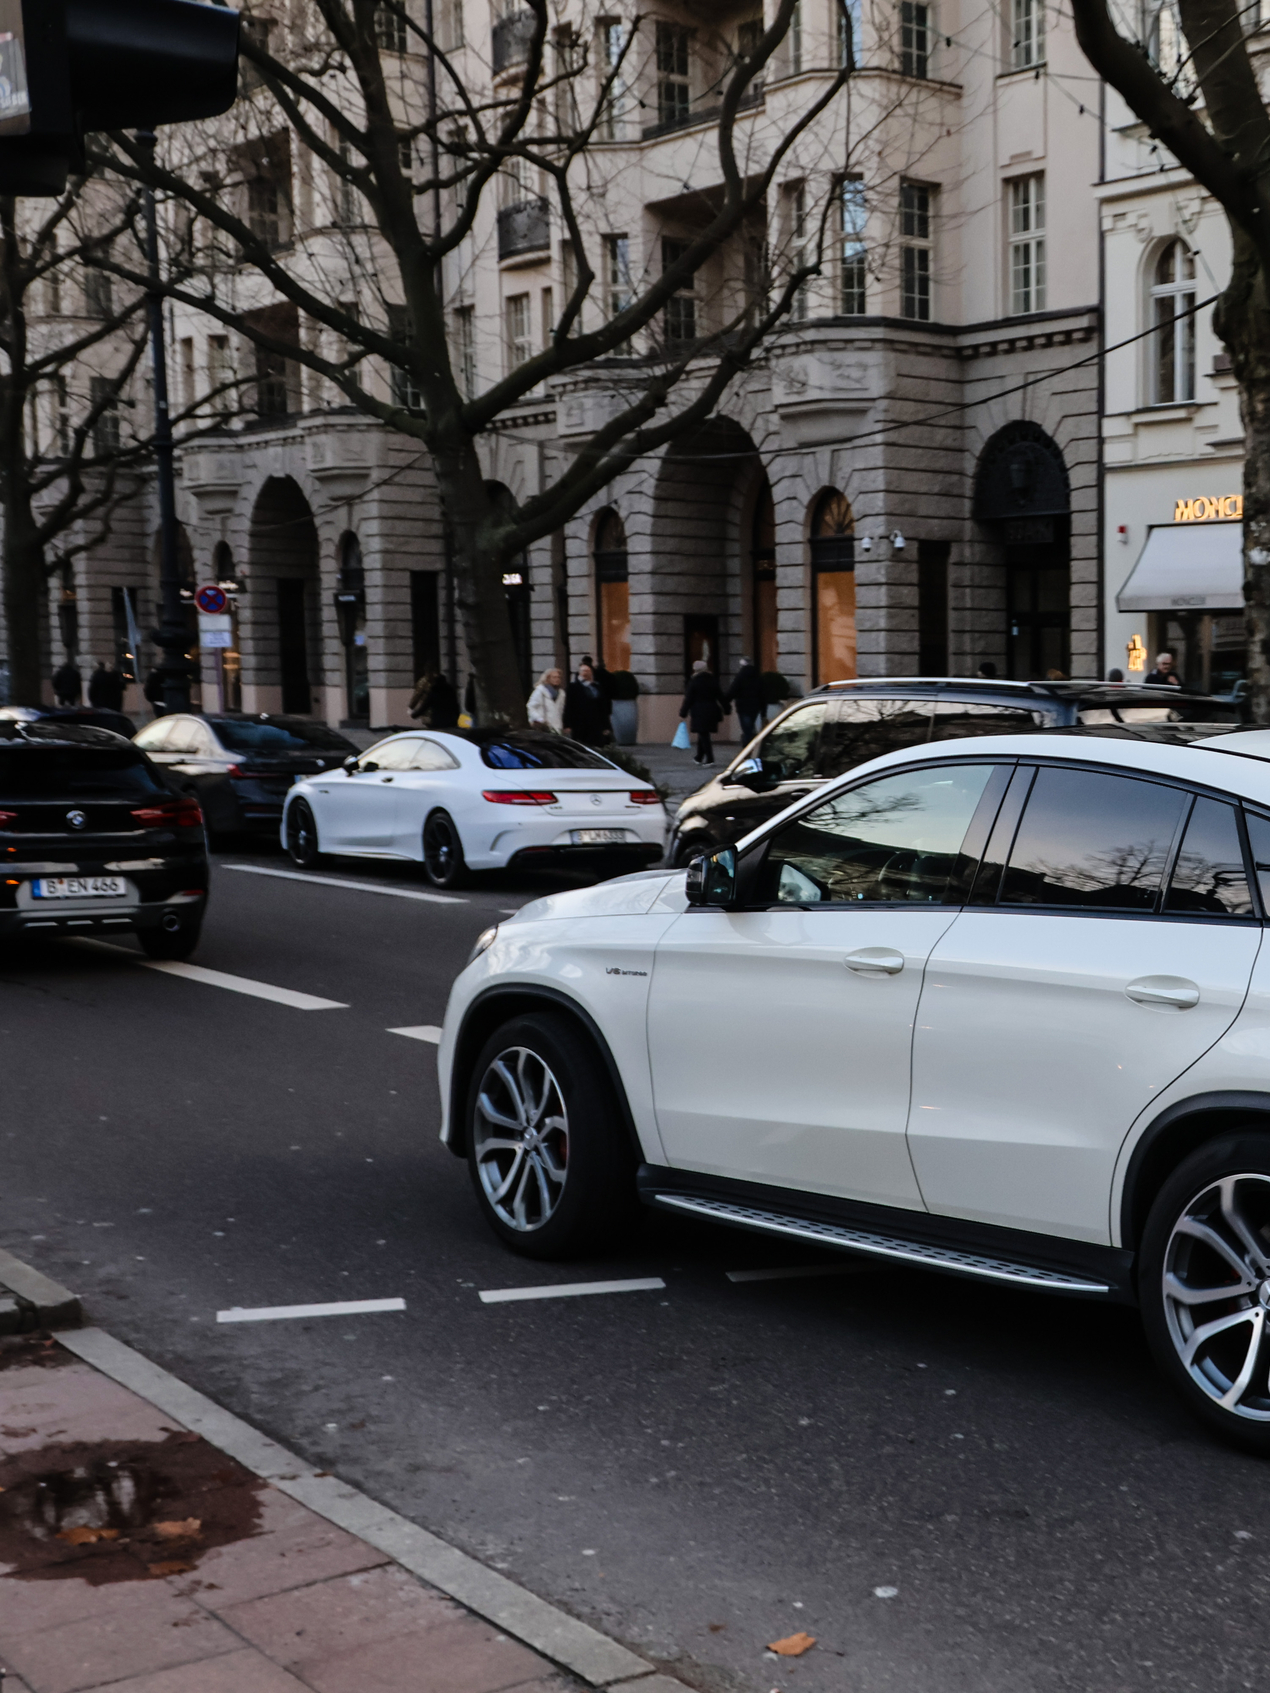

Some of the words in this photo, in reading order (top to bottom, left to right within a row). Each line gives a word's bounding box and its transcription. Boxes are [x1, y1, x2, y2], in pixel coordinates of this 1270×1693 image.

[47, 880, 58, 894] B
[68, 879, 89, 893] EN
[92, 878, 119, 892] 466
